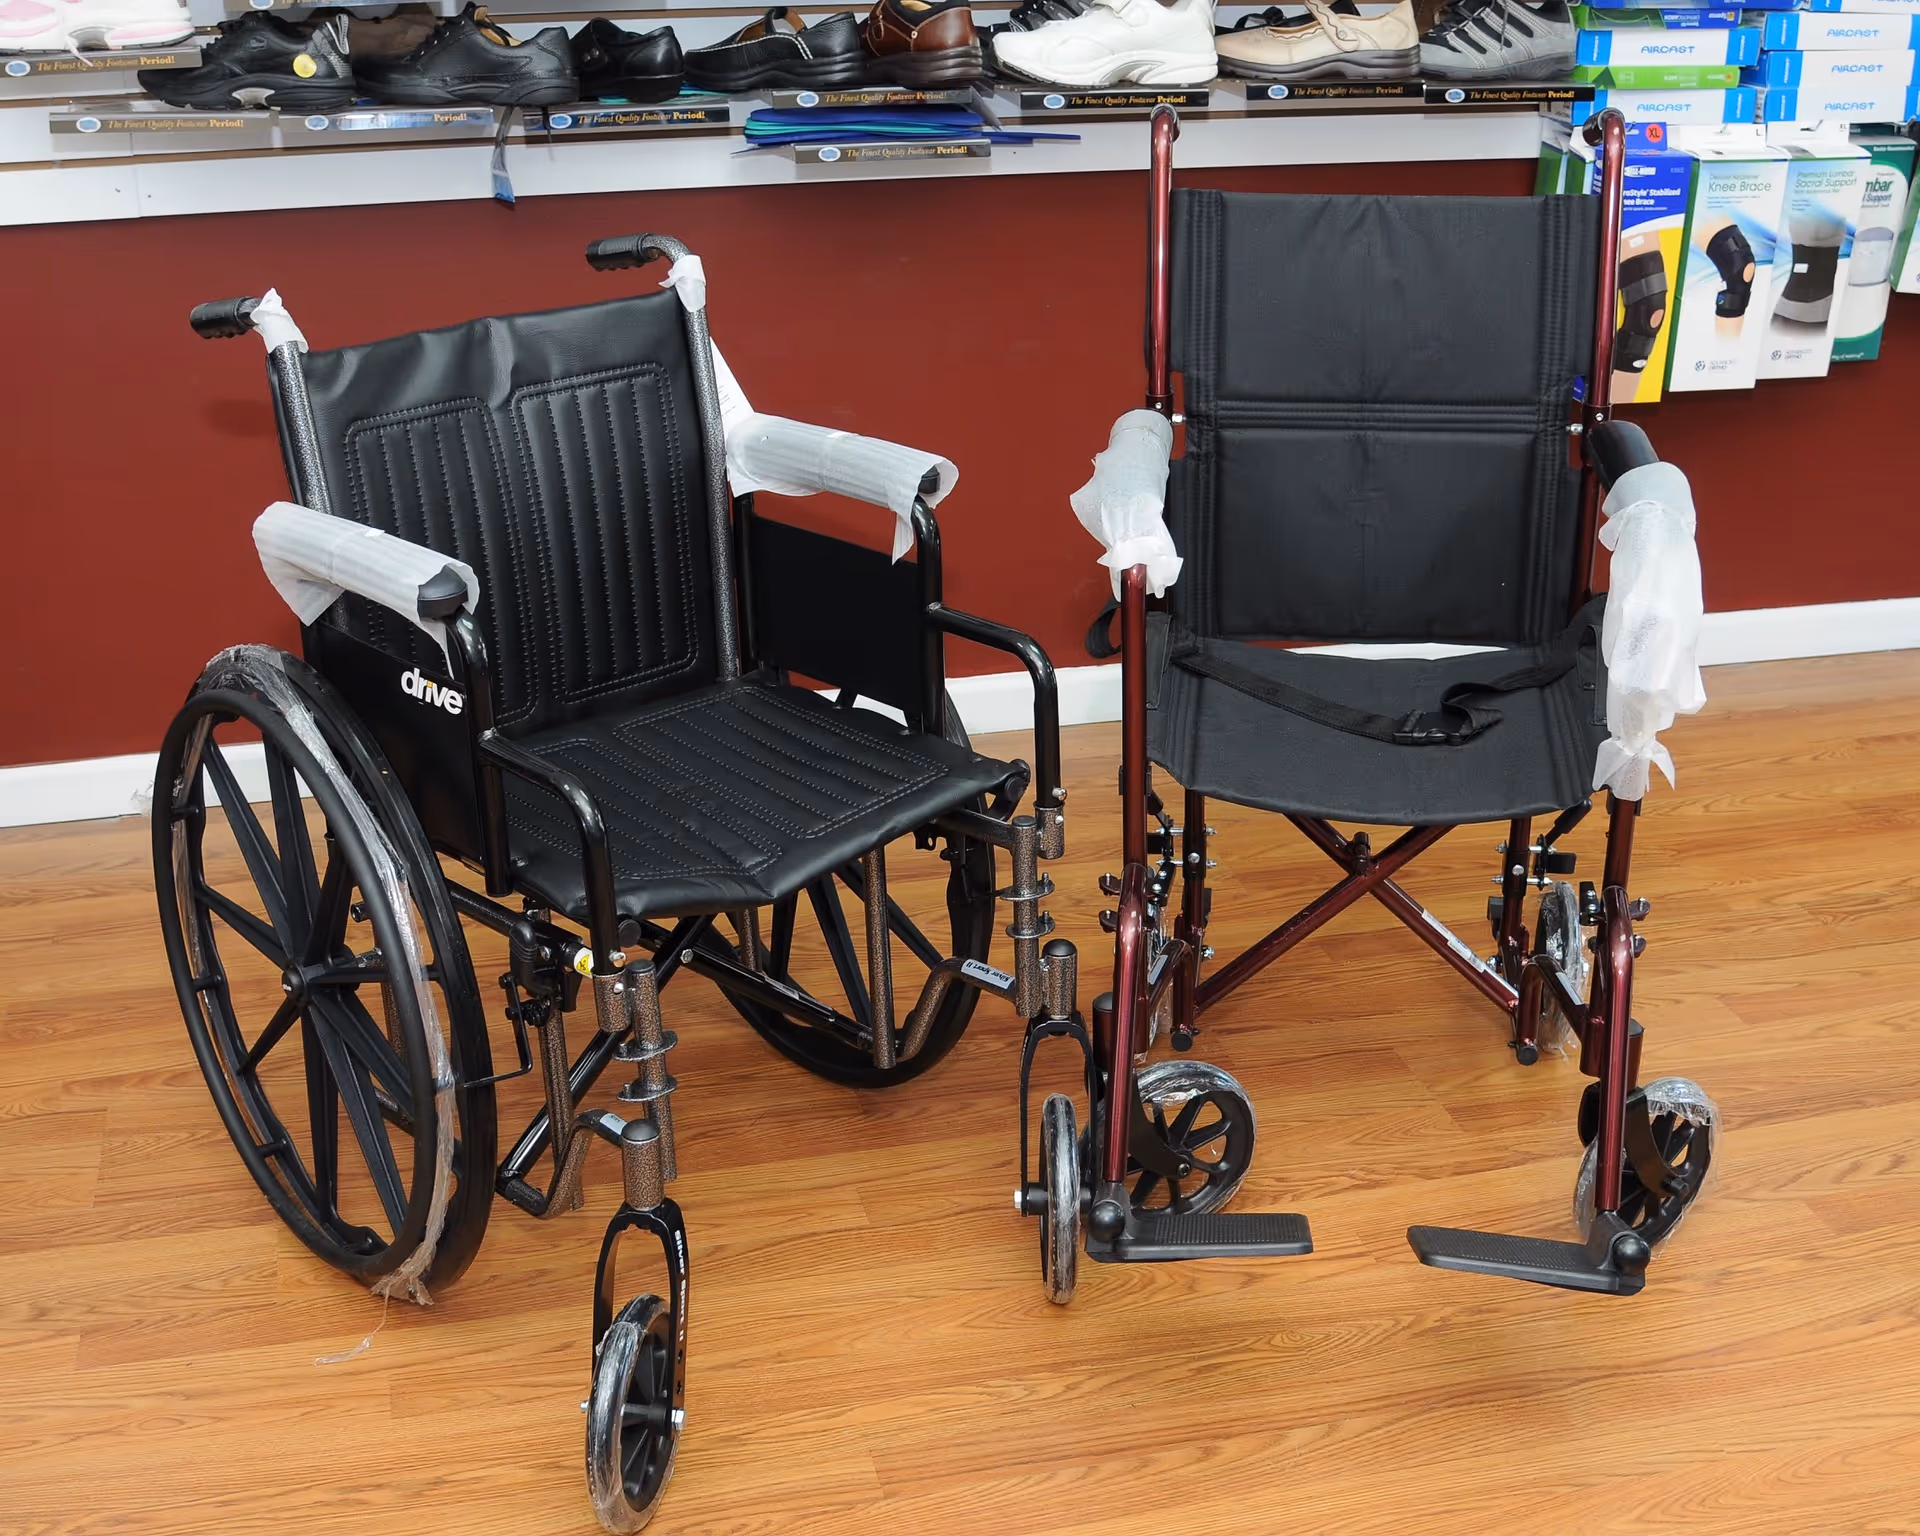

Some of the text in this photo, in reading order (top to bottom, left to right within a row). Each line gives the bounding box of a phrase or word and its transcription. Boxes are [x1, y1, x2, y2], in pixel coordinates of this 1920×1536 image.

[1826, 29, 1880, 37] AIRCAST
[1640, 45, 1695, 54] AIRCAST
[140, 56, 175, 65] Period!
[1831, 64, 1884, 73] AIRCAST
[1306, 87, 1325, 95] Finest
[1470, 91, 1481, 99] The
[1500, 90, 1521, 100] Quality
[825, 94, 838, 103] The
[839, 93, 860, 102] Finest
[860, 93, 885, 104] Quality
[916, 92, 947, 100] Period!
[1070, 97, 1083, 105] The
[1084, 96, 1103, 104] Finest
[1104, 96, 1127, 105] Quality
[1157, 95, 1187, 103] Period!
[1636, 104, 1691, 112] AIRCAST
[1824, 102, 1875, 111] AIRCAST
[434, 113, 467, 122] Period!
[578, 115, 591, 124] The
[593, 113, 614, 123] Finest
[615, 113, 640, 125] Quality
[672, 111, 705, 120] Period!
[108, 120, 122, 129] The
[124, 120, 146, 128] Finest
[148, 120, 174, 130] Quality
[209, 119, 244, 128] Period!
[1648, 127, 1660, 139] XL
[846, 149, 859, 158] The
[861, 149, 881, 157] Finest
[882, 148, 906, 158] Quality
[936, 145, 968, 154] Period!
[1708, 181, 1772, 192] Knee Brace
[1795, 178, 1857, 188] Sacral Support
[1865, 177, 1893, 192] mbar
[401, 667, 463, 715] drive
[973, 963, 991, 975] Sport
[990, 970, 1010, 982] Silver
[674, 1229, 685, 1276] Silver
